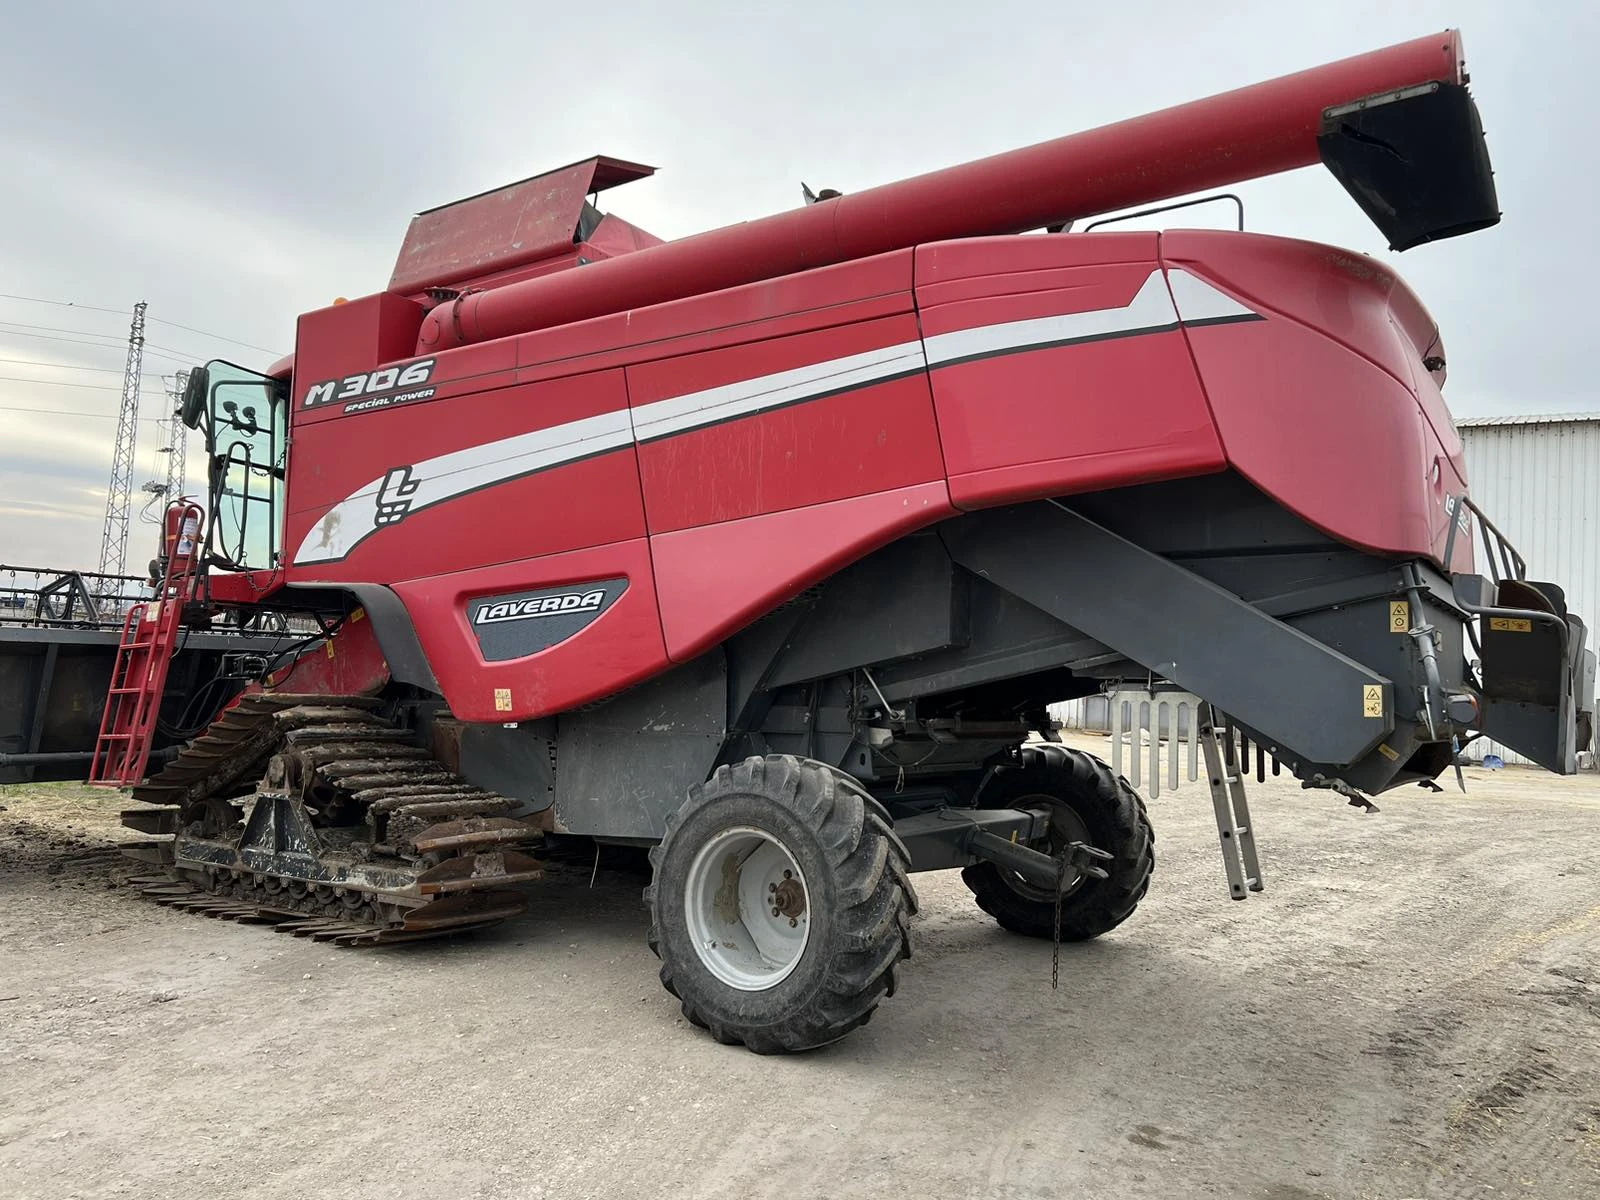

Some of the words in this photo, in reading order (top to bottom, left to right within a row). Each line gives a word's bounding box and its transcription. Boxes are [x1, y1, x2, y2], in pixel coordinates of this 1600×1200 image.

[305, 381, 336, 406] M
[338, 359, 434, 399] 306
[393, 389, 435, 402] POWER
[476, 592, 604, 625] LAVERDA
